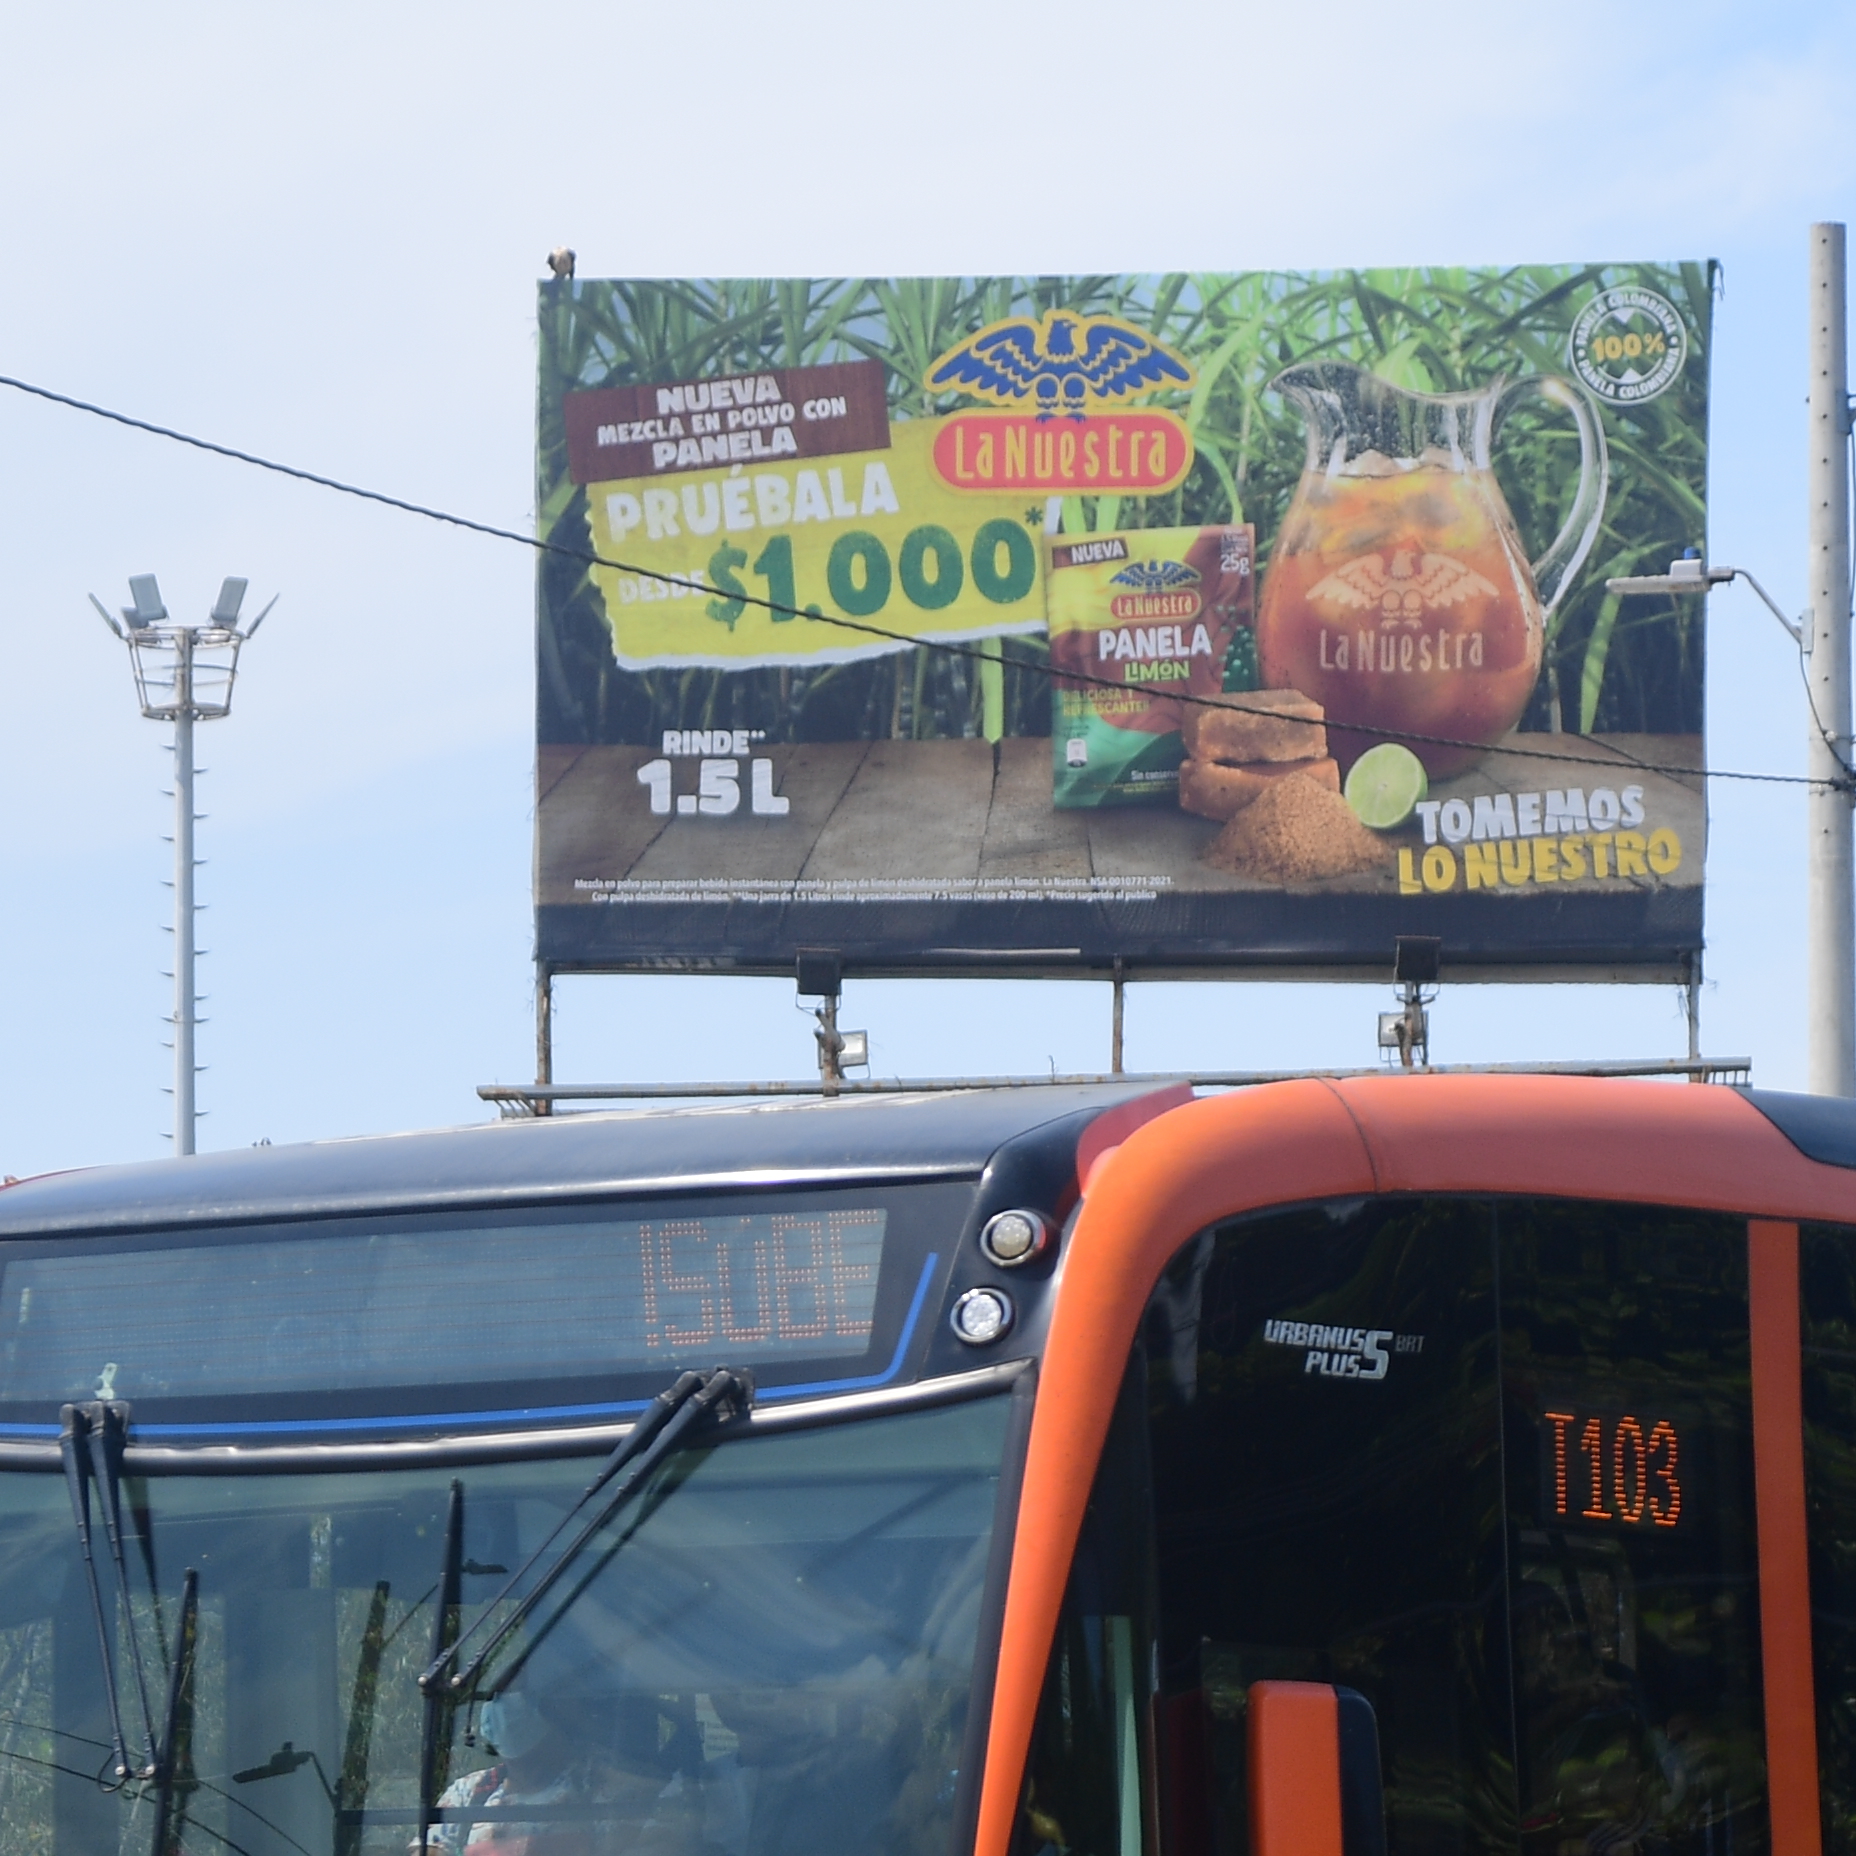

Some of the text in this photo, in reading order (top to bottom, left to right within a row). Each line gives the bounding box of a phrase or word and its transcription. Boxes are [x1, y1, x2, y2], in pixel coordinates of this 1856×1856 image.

[1592, 331, 1665, 362] 100%
[656, 375, 782, 414] NUEVA
[597, 396, 847, 446] MEZCLA EN POLVO CON
[652, 426, 798, 470] PANELA
[606, 462, 900, 543] PRUÉBALA
[1071, 539, 1125, 565] NUEVA
[1220, 554, 1250, 575] 25g
[618, 570, 706, 604] DESDE
[1099, 624, 1213, 661] PANELA
[1125, 658, 1190, 683] LIMÓN
[751, 759, 790, 815] L
[1415, 785, 1645, 844] TOMEMOS
[1397, 827, 1683, 895] LO NUESTRO
[1544, 1411, 1682, 1527] T103
